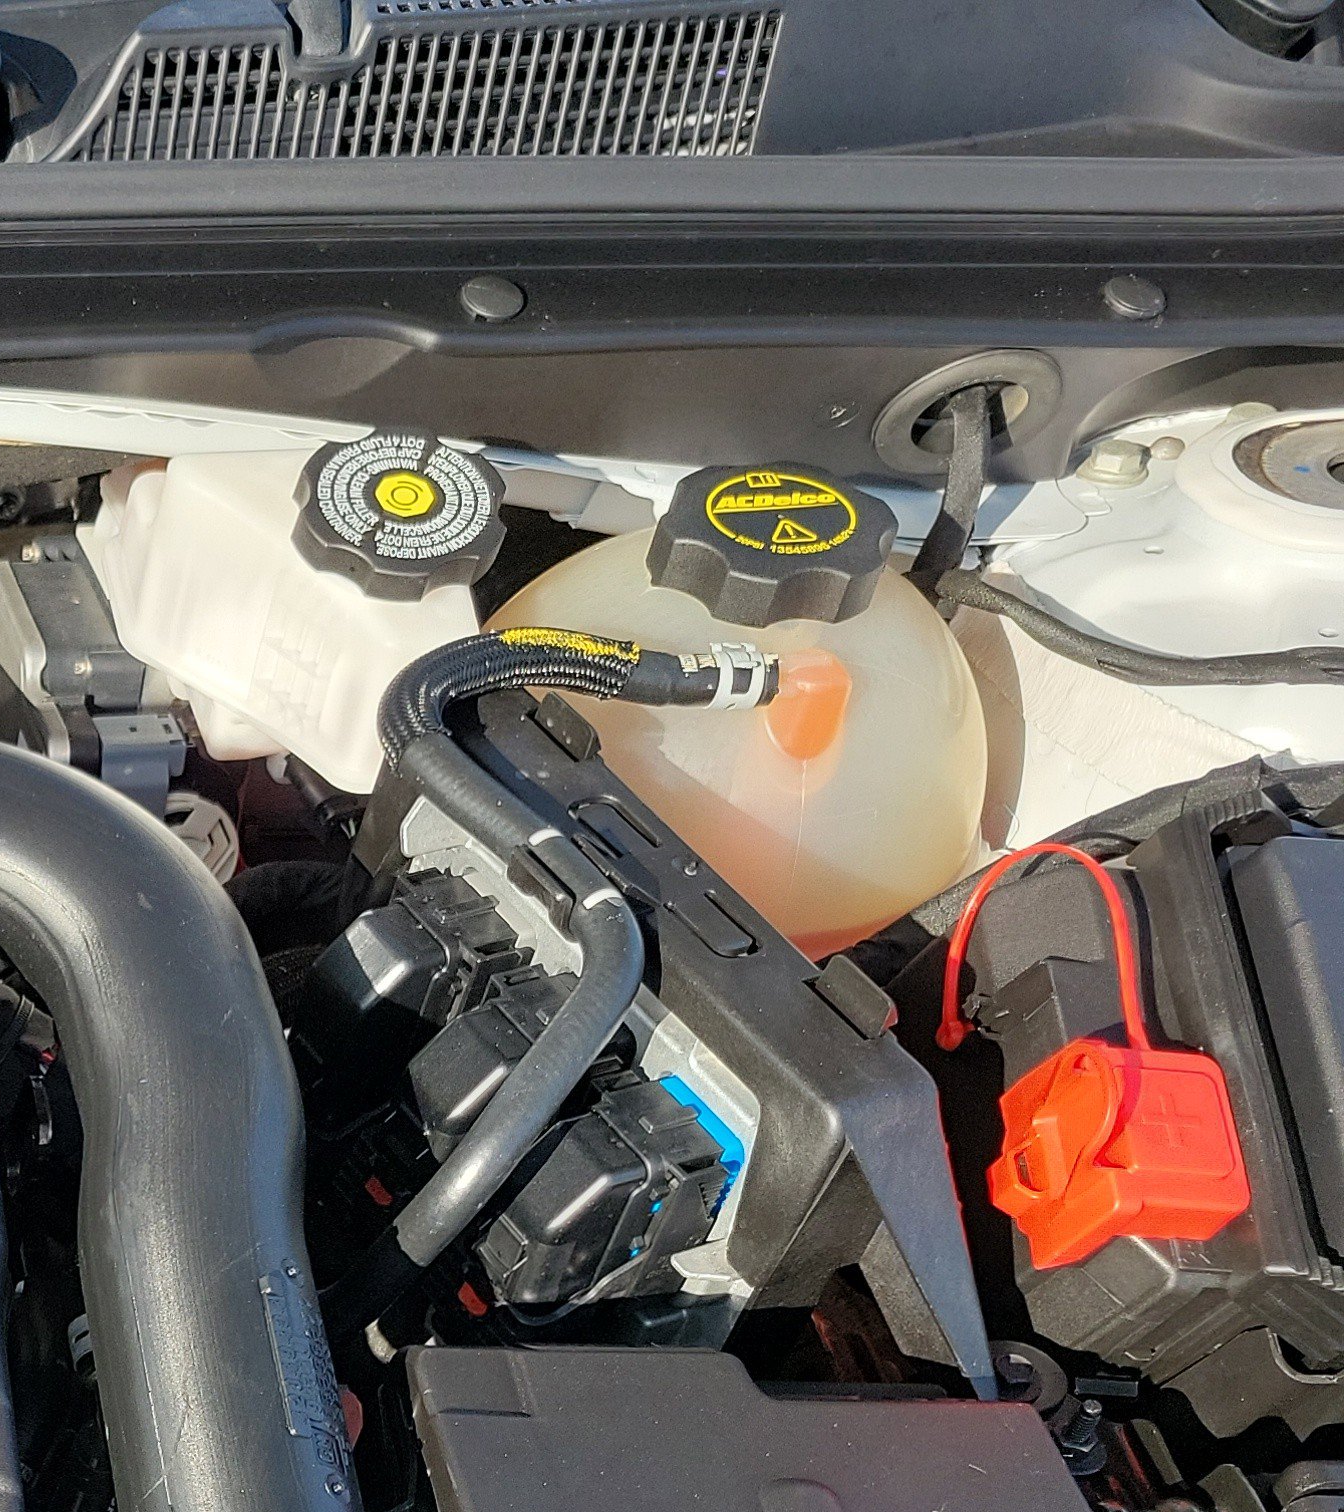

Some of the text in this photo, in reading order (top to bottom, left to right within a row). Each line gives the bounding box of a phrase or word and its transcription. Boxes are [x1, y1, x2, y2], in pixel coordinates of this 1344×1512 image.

[362, 436, 392, 451] FLUID
[393, 436, 400, 447] 4
[400, 437, 425, 448] DOT
[335, 444, 362, 463] FROM
[355, 447, 397, 468] BEFORE
[398, 448, 422, 460] CAP
[317, 469, 336, 499] SEALED
[350, 472, 369, 498] CLEAN
[335, 499, 351, 517] USE
[715, 492, 836, 509] ACDelco
[350, 499, 379, 526] FILLER
[345, 514, 373, 534] ONLY
[381, 535, 402, 546] DOT
[404, 535, 432, 547] FREIN
[417, 543, 450, 560] AVANT
